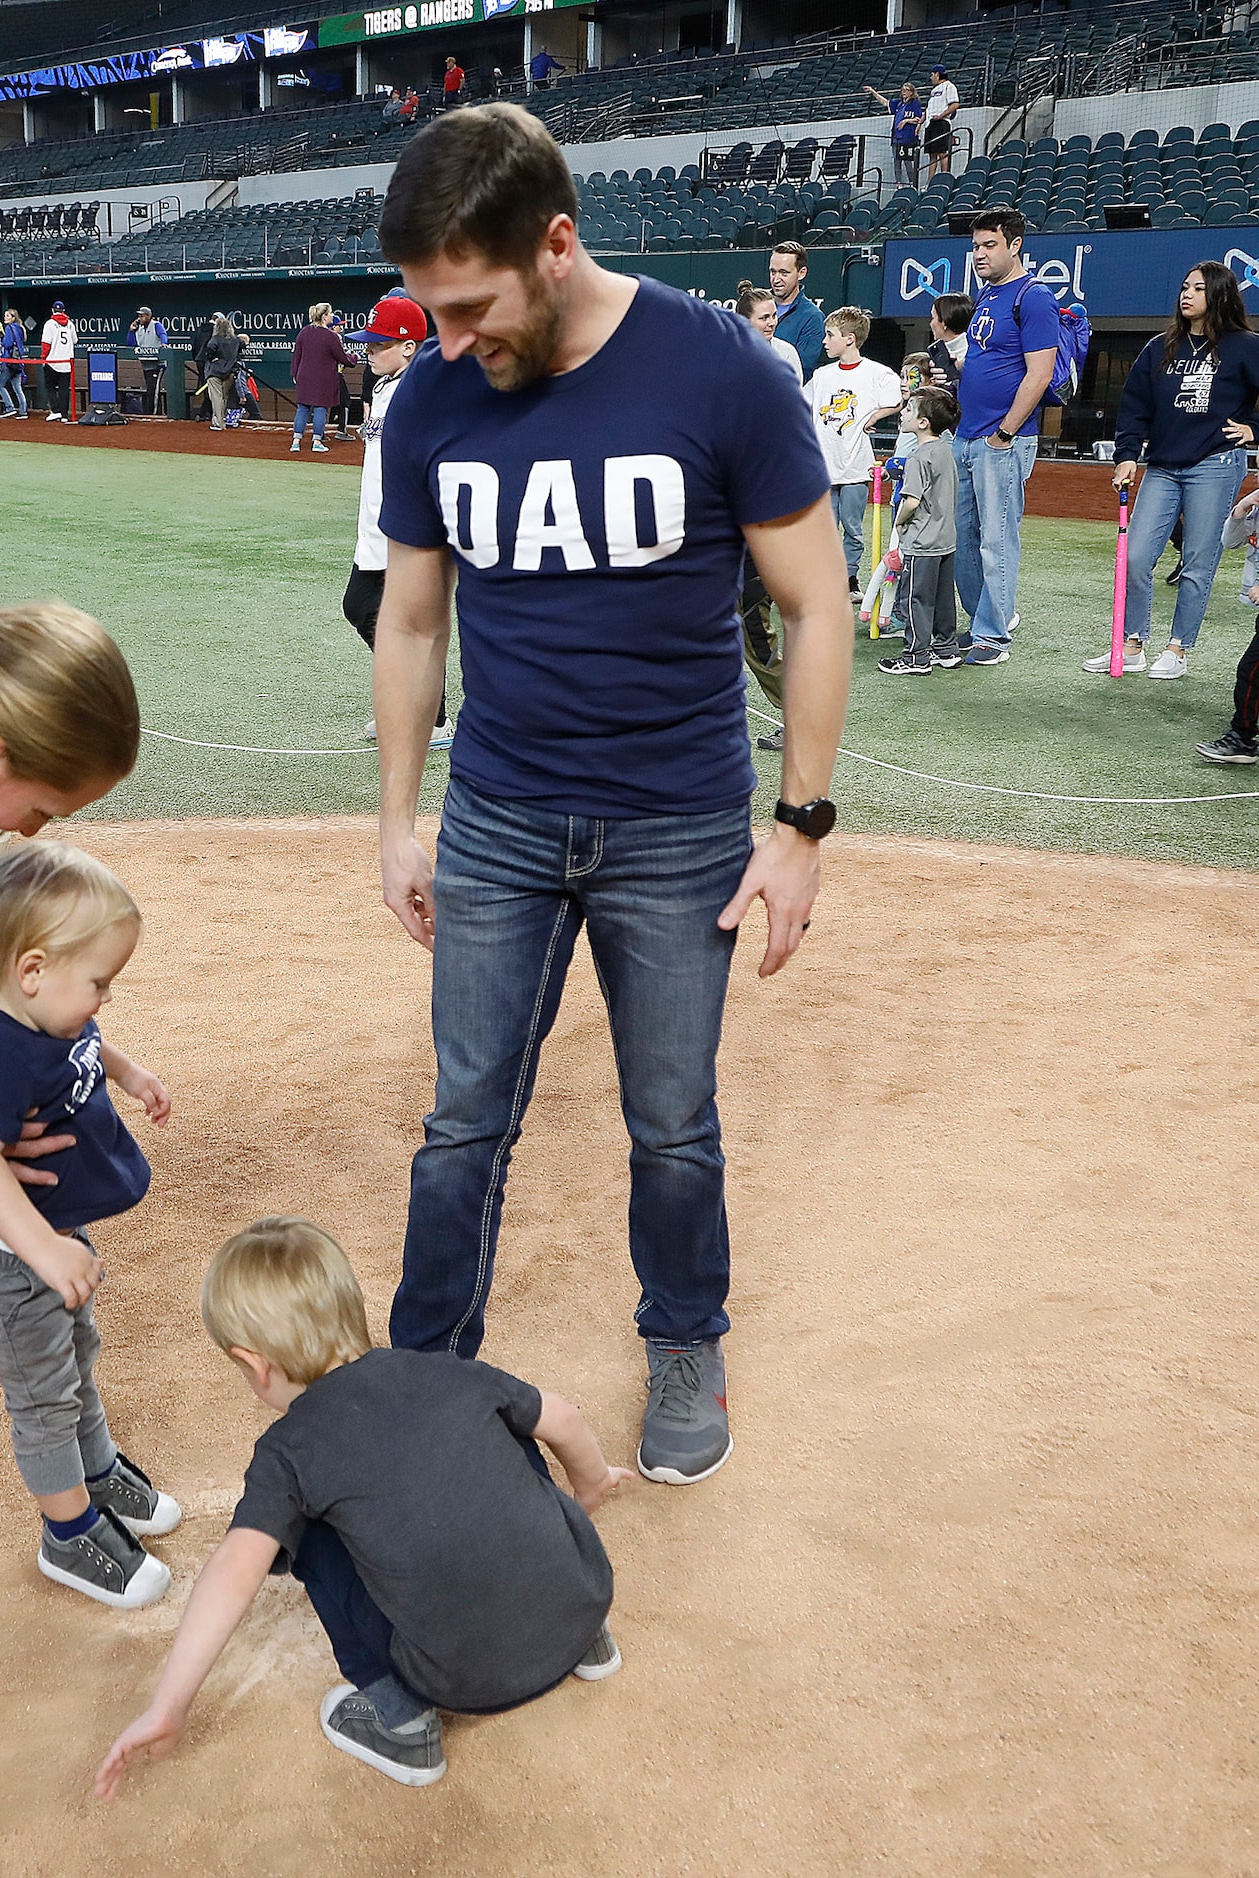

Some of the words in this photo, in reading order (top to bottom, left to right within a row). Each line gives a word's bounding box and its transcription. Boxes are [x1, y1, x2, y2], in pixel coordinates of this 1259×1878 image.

[364, 10, 402, 36] TIGERS
[404, 5, 418, 28] @
[420, 0, 474, 26] RANGERS
[71, 317, 120, 333] HOCTAW
[233, 309, 304, 330] CHOCTAW
[60, 331, 68, 345] 5
[437, 453, 686, 572] DAD
